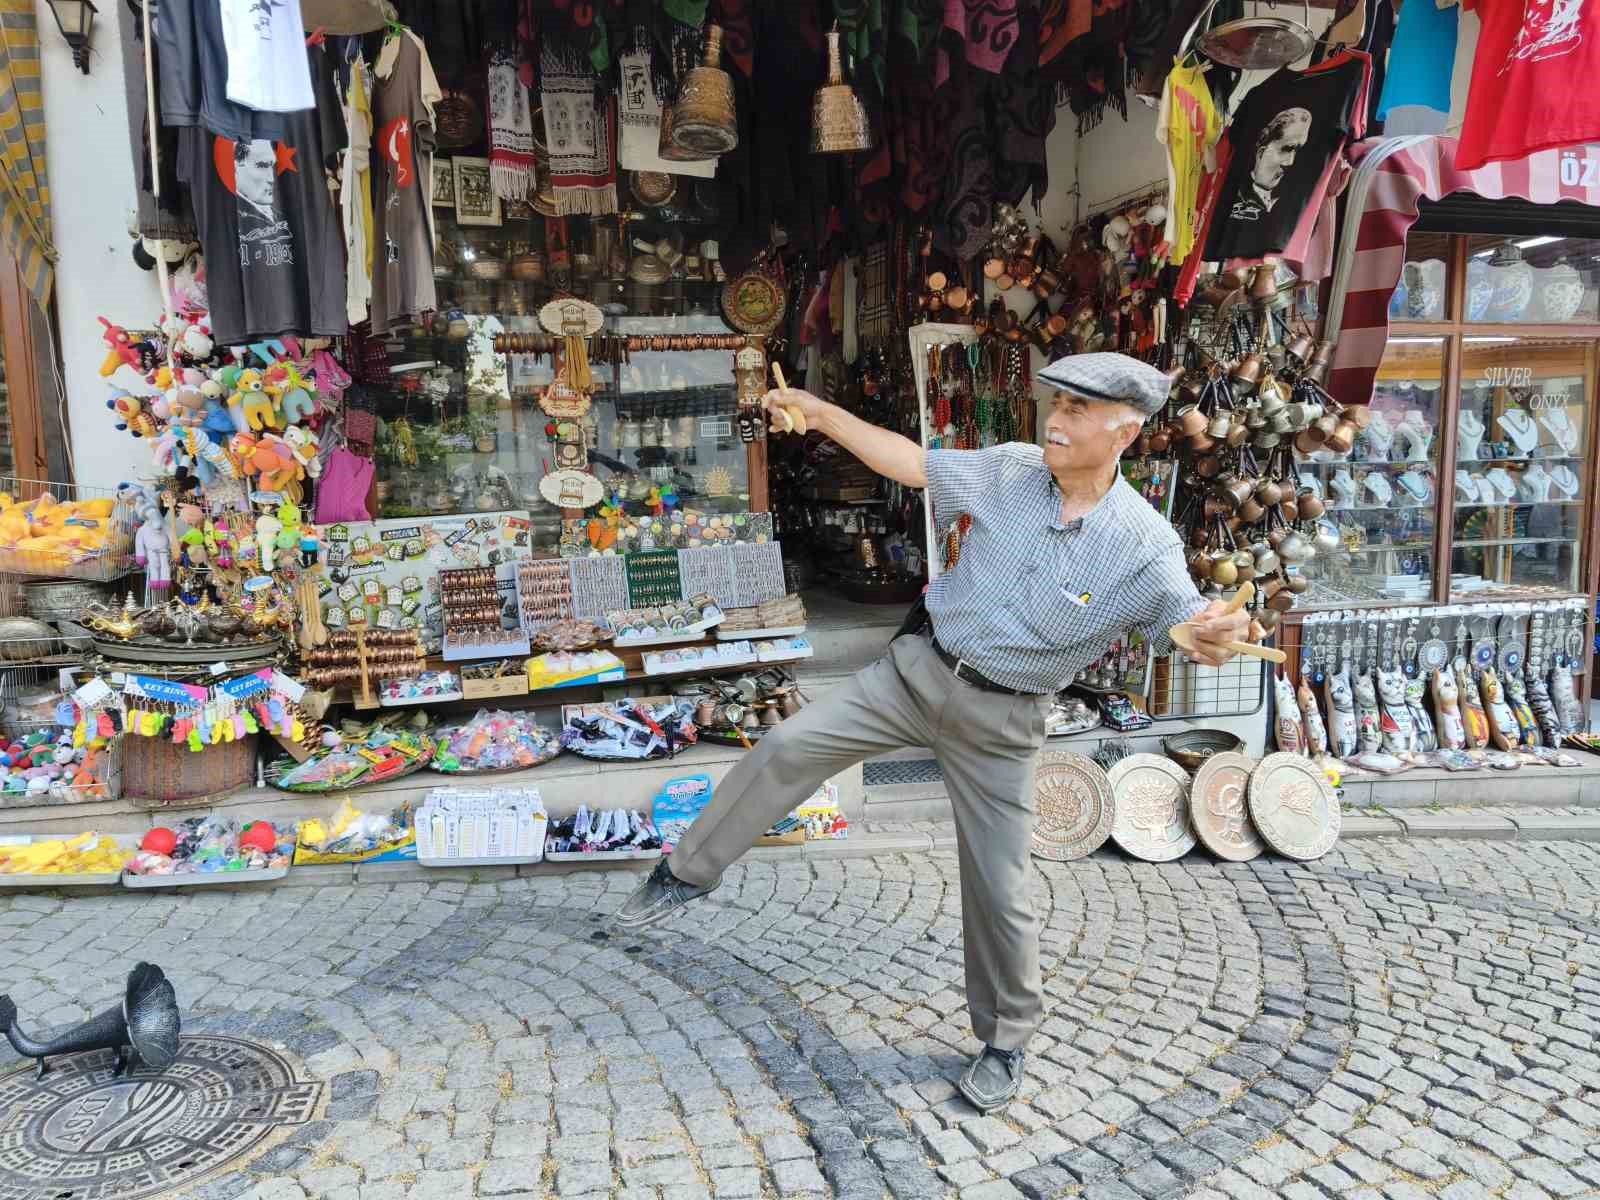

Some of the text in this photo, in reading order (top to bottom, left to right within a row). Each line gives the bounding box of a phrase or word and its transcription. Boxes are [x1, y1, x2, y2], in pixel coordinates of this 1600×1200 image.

[1484, 367, 1532, 387] SILVER
[1529, 394, 1570, 410] ONYX
[143, 683, 188, 697] KEY RING
